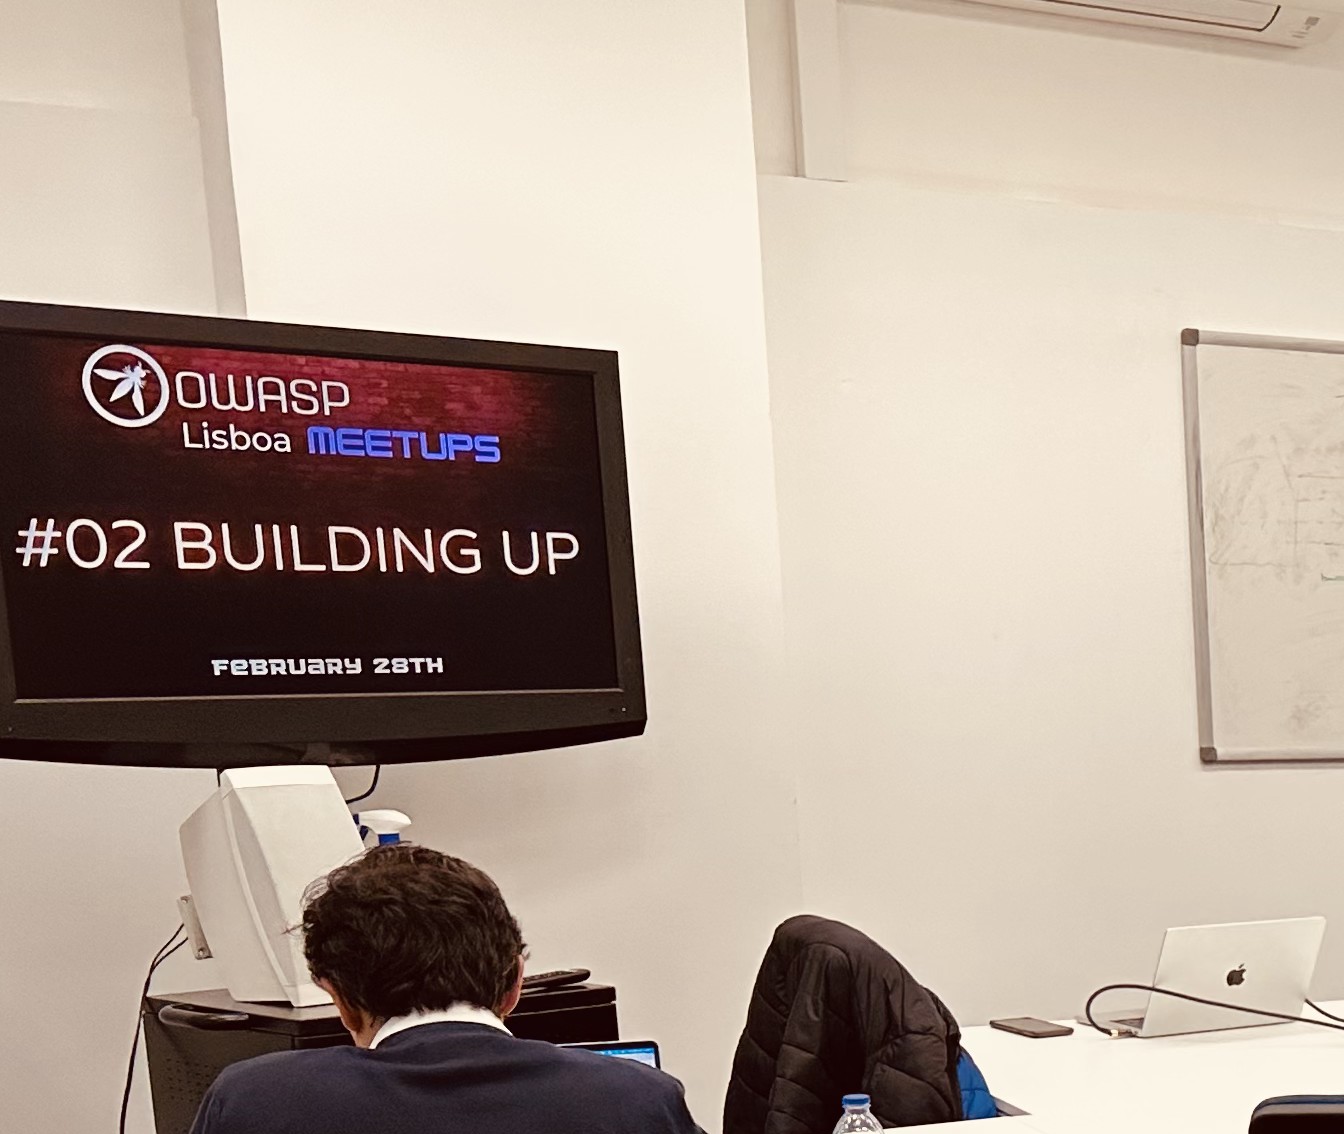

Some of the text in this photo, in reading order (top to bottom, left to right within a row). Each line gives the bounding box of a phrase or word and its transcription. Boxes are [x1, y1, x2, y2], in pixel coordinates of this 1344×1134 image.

[175, 371, 350, 416] OWASP
[182, 421, 501, 463] Lisboa MEETUPS
[15, 517, 580, 576] #02 BUILDING UP
[372, 656, 444, 675] 28TH
